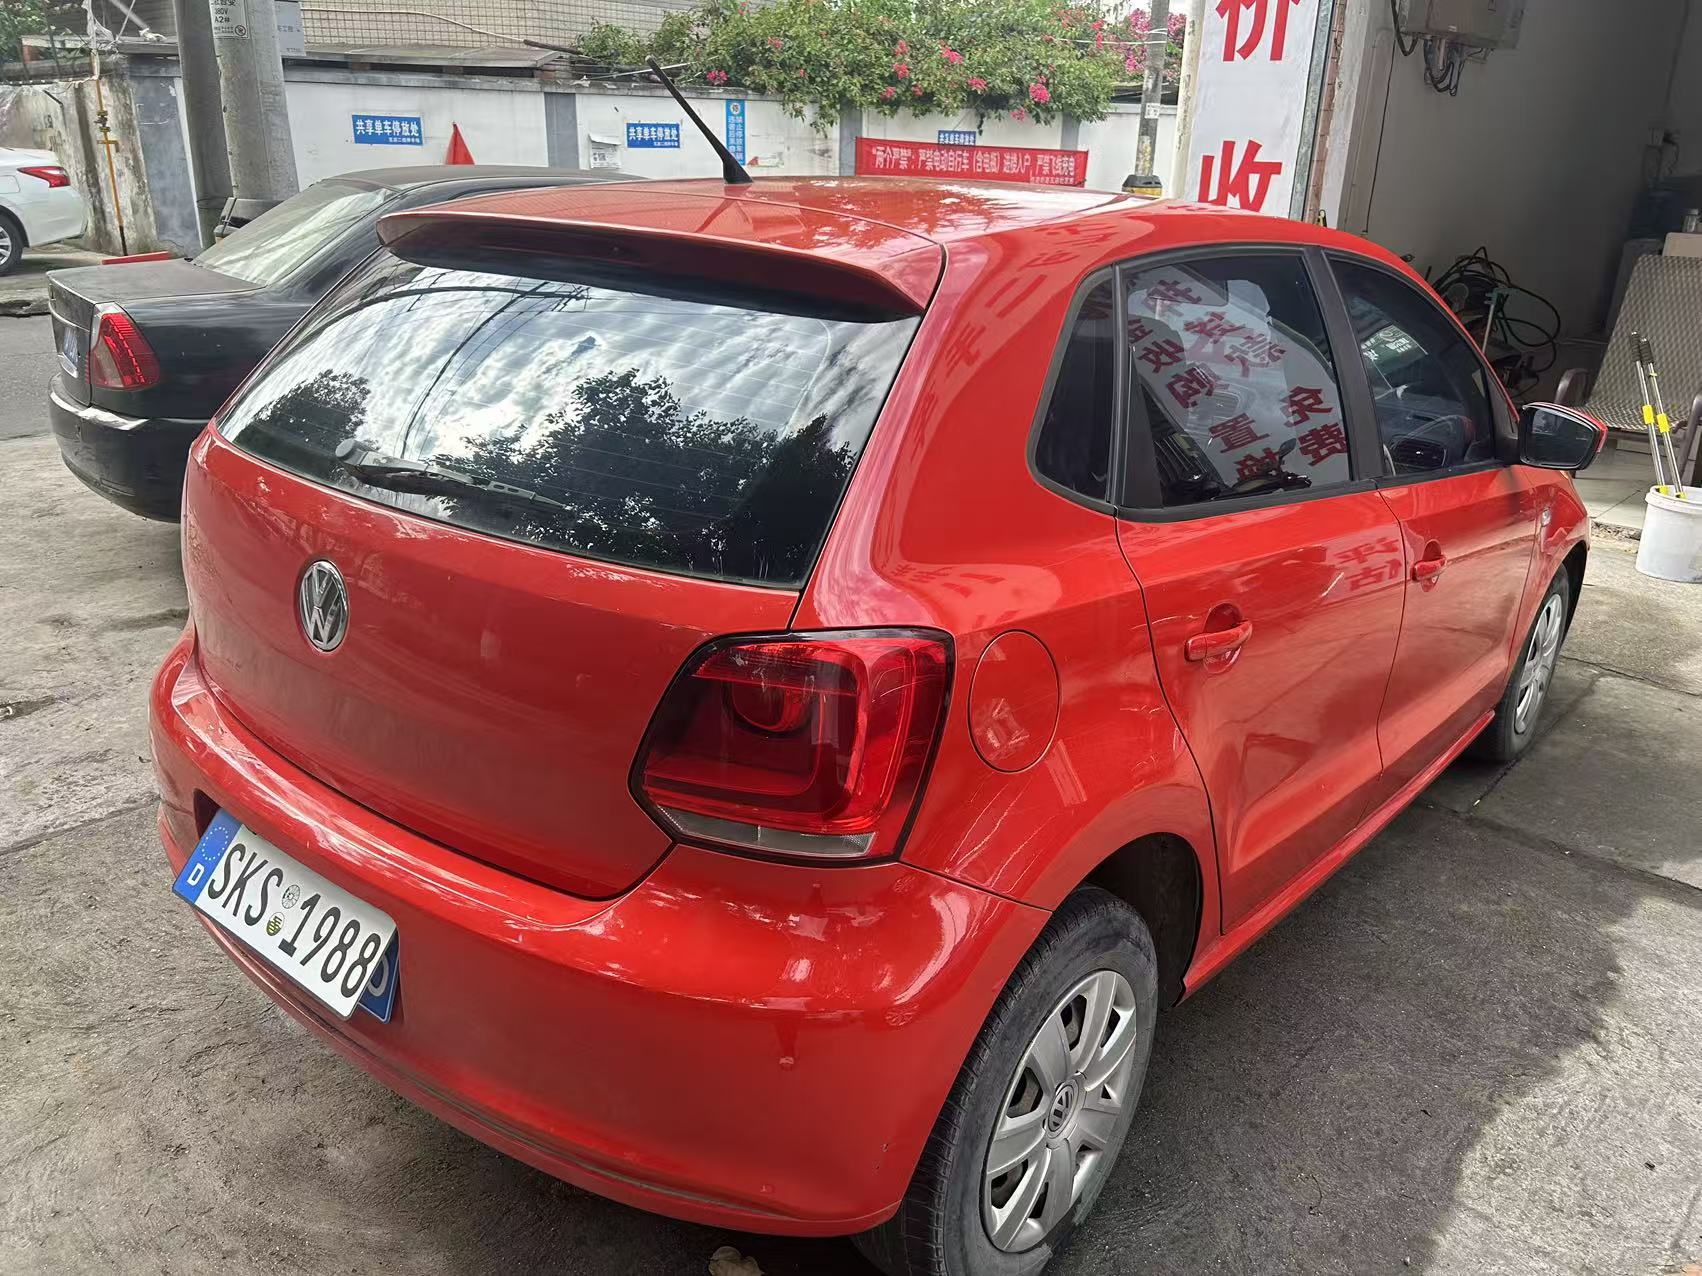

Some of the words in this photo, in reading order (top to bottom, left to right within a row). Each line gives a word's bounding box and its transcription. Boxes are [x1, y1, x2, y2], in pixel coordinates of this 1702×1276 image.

[355, 119, 419, 136] 共享单车停放处
[628, 126, 679, 140] 共享单车停放处
[187, 863, 205, 886] D
[207, 843, 284, 926] SKS
[278, 893, 381, 998] 1988
